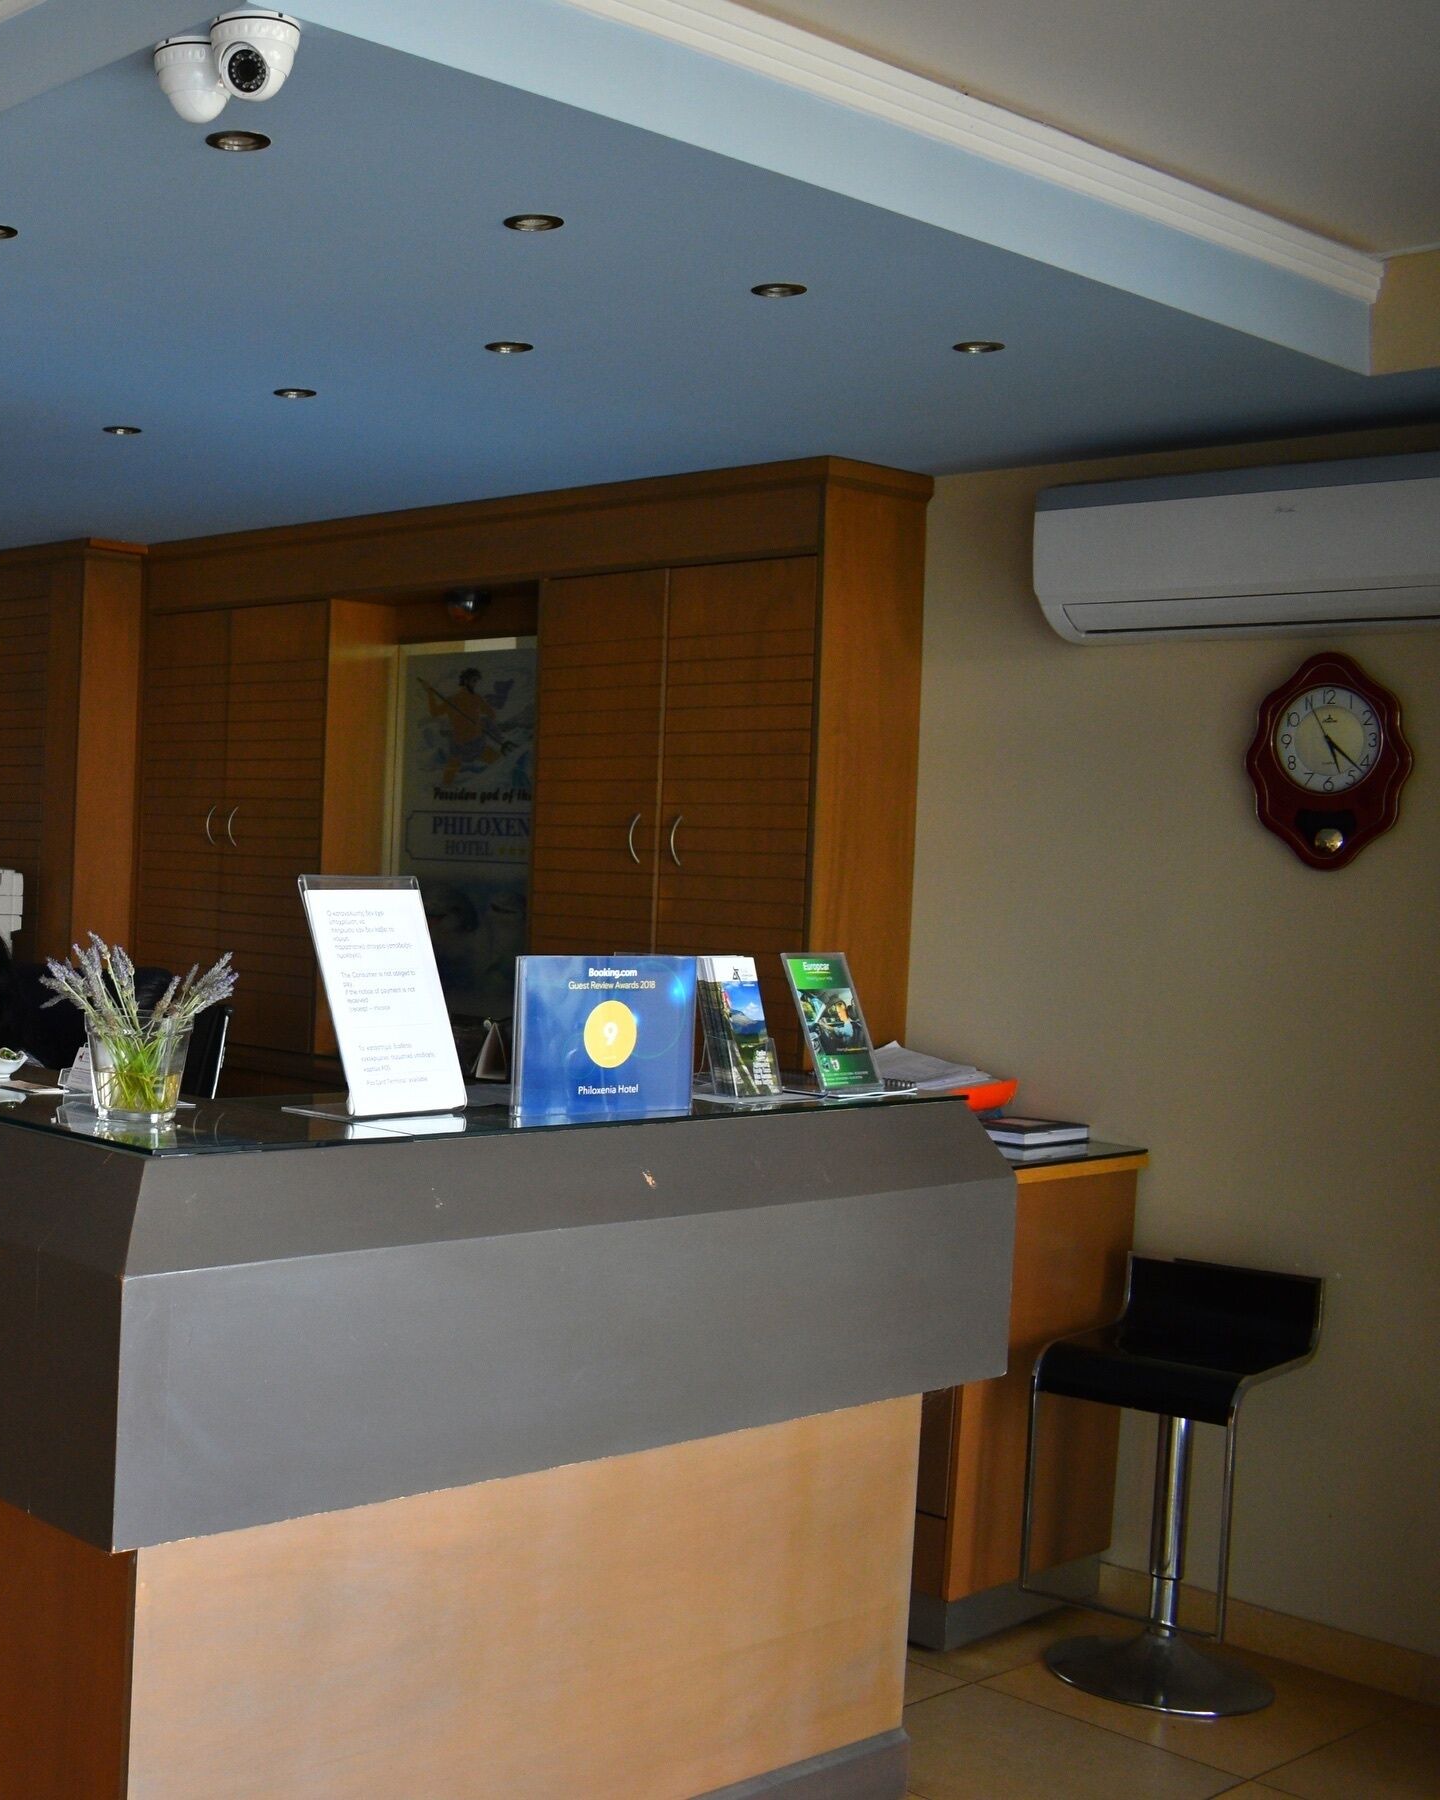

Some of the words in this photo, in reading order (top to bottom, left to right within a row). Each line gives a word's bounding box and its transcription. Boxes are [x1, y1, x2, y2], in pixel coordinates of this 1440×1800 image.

[1323, 689, 1336, 705] 12
[1287, 712, 1300, 727] 10
[1362, 710, 1372, 726] 2
[1281, 733, 1292, 749] 9
[1368, 732, 1377, 748] 3
[1287, 755, 1296, 770] 8
[1360, 754, 1371, 767] 4
[1304, 772, 1314, 787] 7
[1323, 776, 1334, 792] 6
[1345, 770, 1356, 786] 5
[480, 787, 498, 803] god
[502, 787, 514, 803] of
[445, 839, 493, 856] HOTEL
[588, 967, 638, 979] Booking.com
[802, 961, 830, 972] Europcar
[568, 981, 590, 990] Guest
[590, 981, 614, 989] Review
[614, 980, 640, 989] Awards
[603, 1021, 618, 1045] 9
[578, 1085, 617, 1095] Philoxenia
[618, 1084, 639, 1093] Hotel
